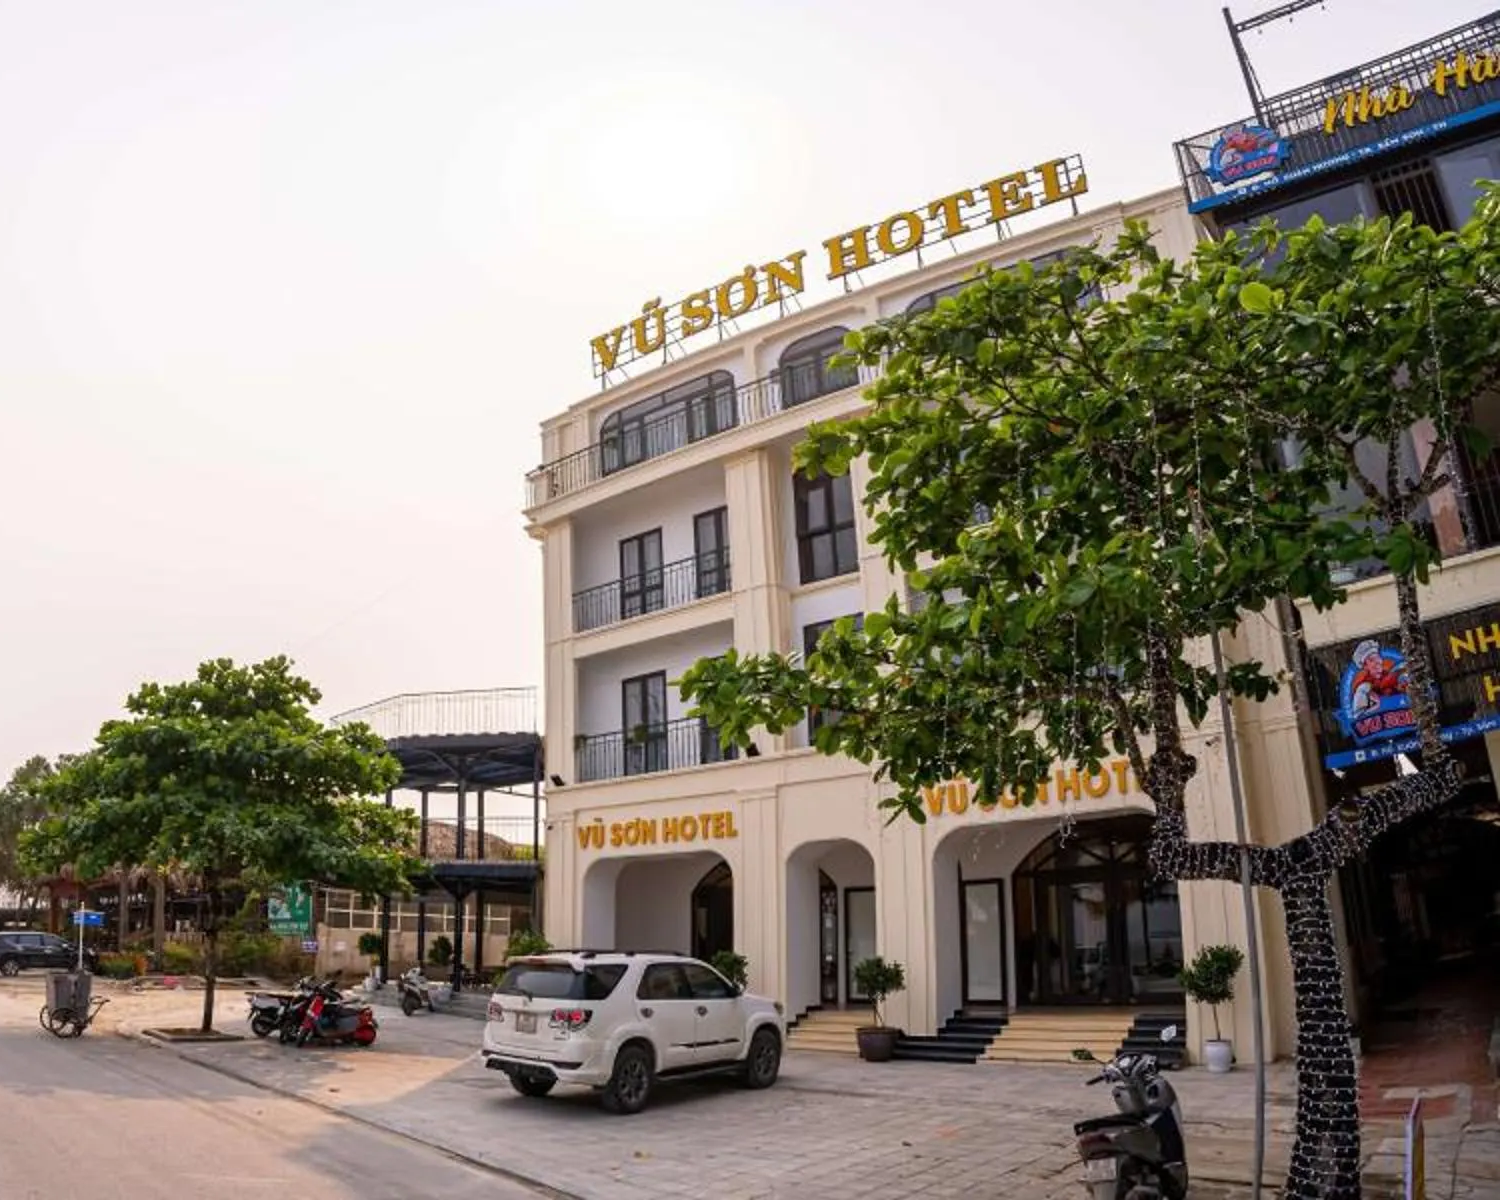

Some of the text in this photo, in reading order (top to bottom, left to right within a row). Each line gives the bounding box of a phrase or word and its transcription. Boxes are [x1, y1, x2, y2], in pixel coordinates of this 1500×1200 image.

[590, 158, 1089, 372] VŨ SƠN HOTEL
[578, 811, 739, 849] VŨ SƠN HOTEL
